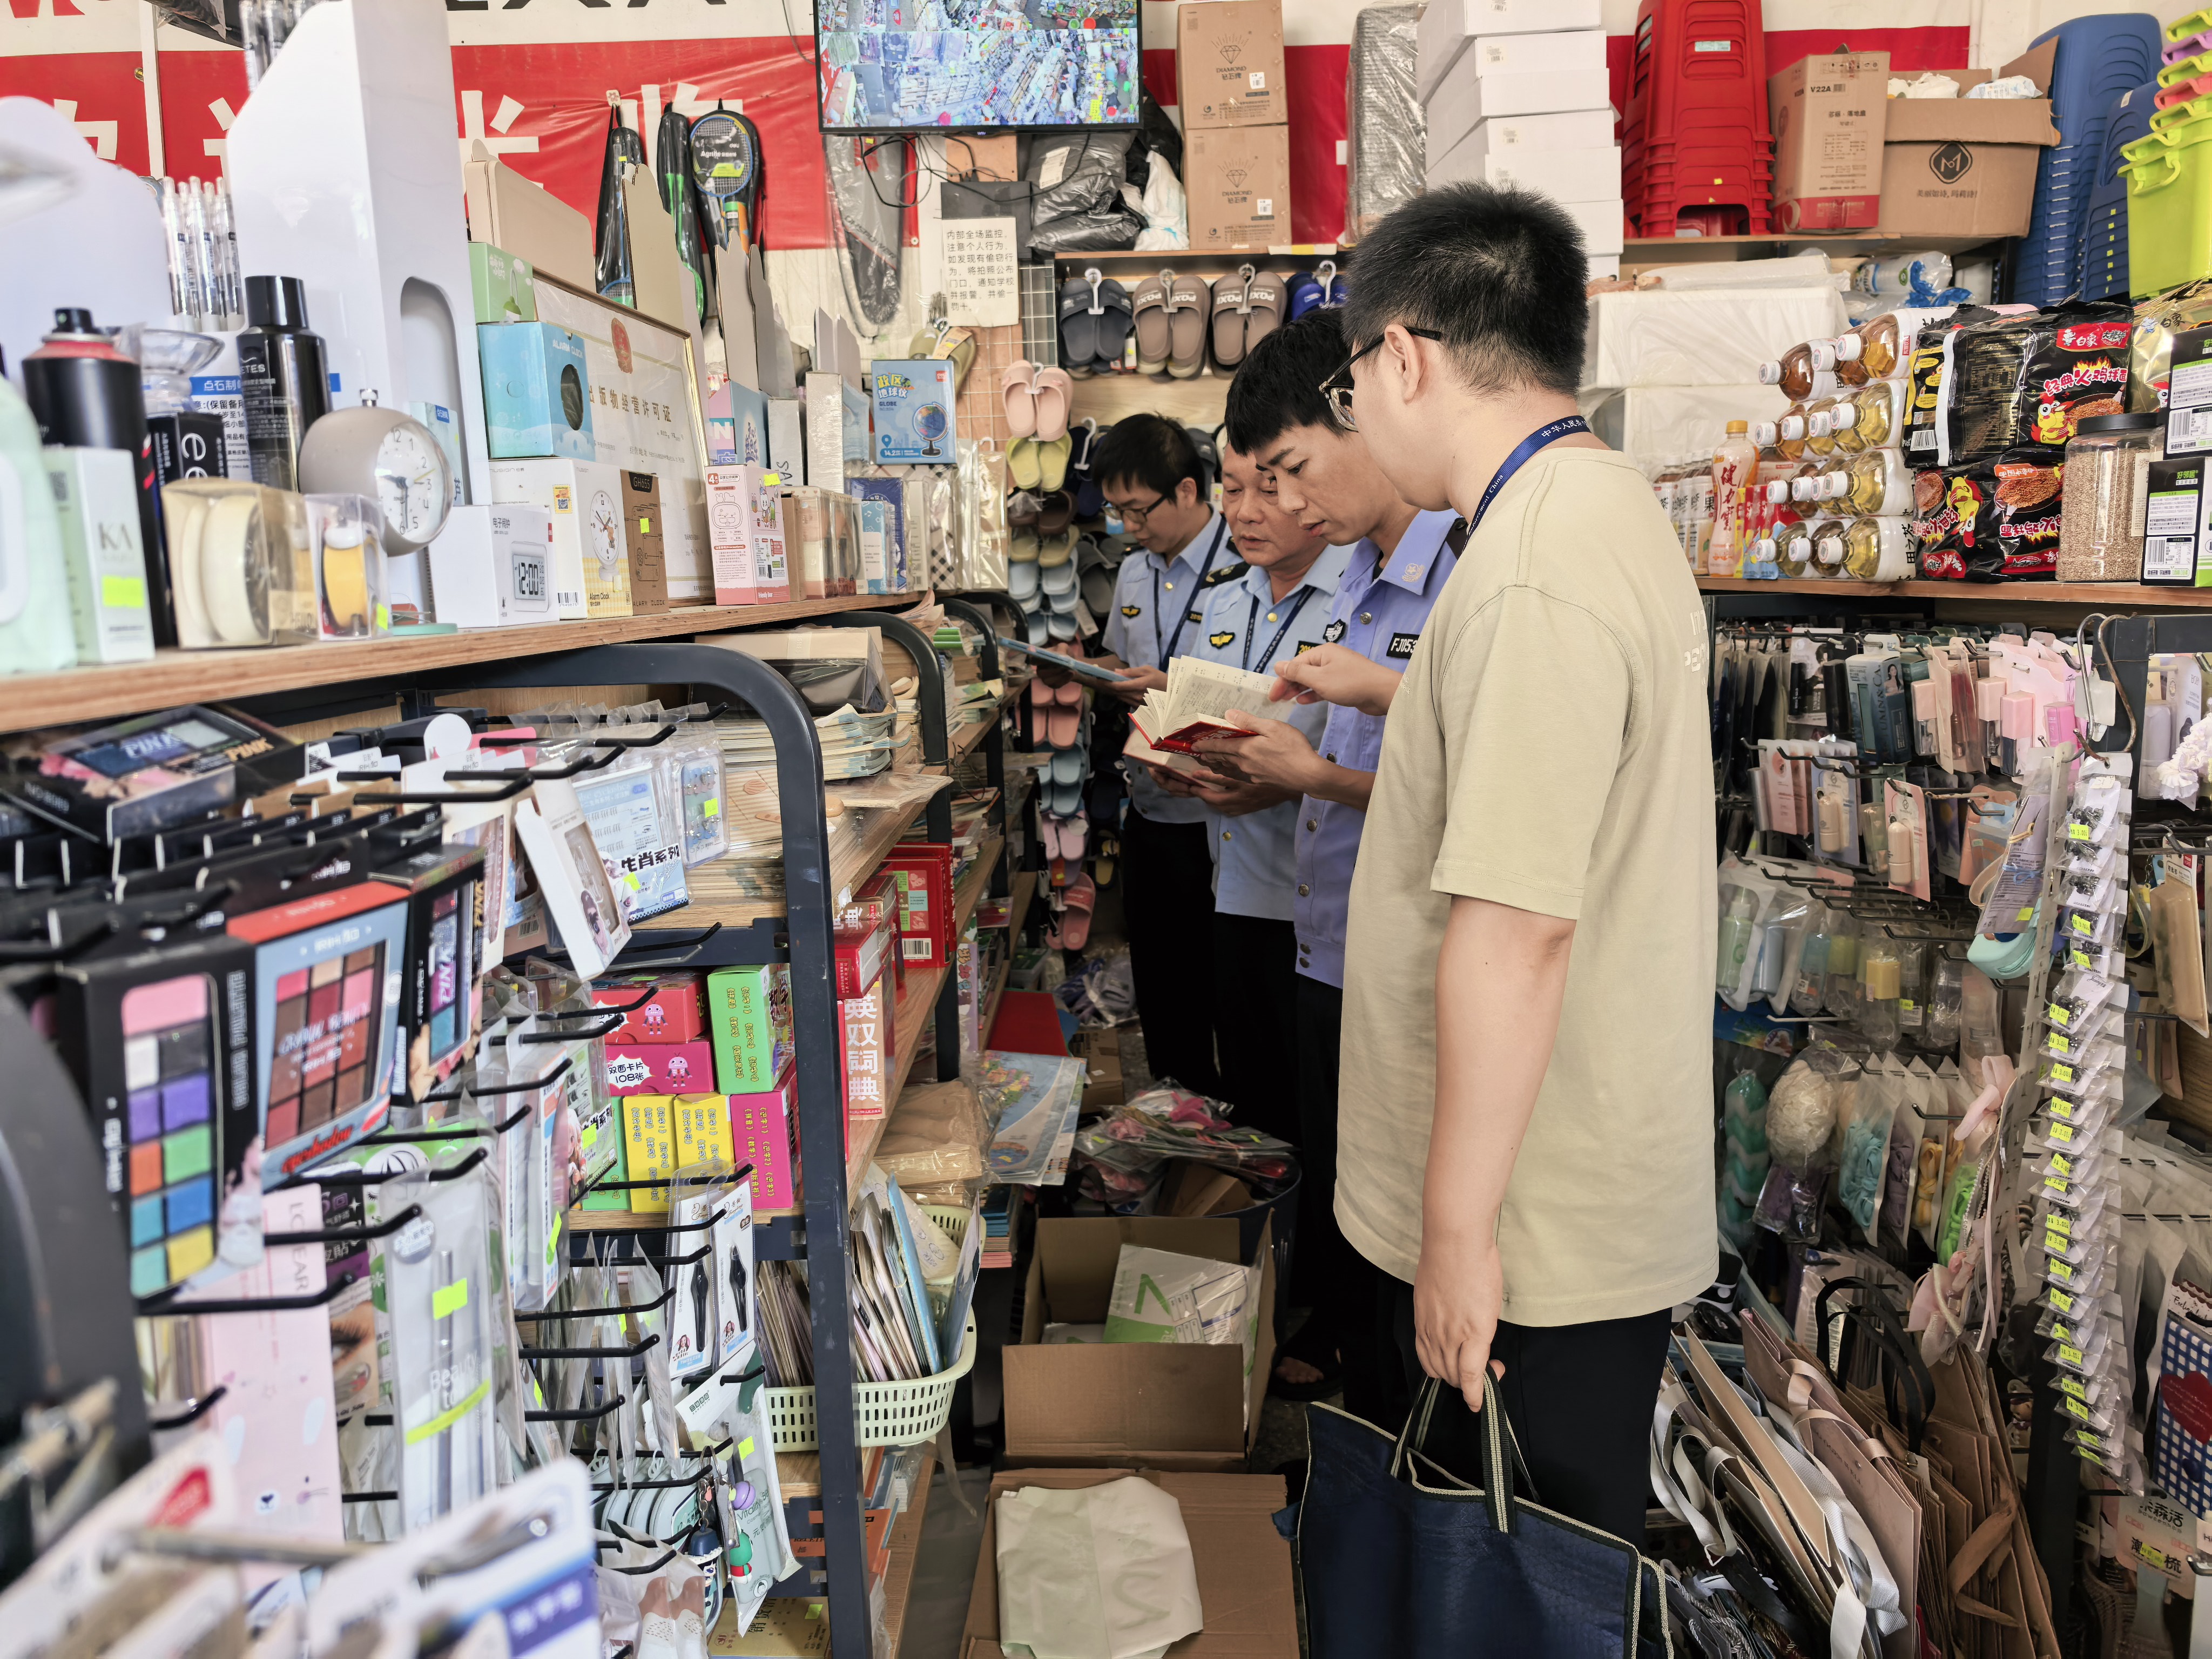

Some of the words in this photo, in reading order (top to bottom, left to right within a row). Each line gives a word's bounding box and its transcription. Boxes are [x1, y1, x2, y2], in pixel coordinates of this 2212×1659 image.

[2160, 312, 2186, 328] 白象
[553, 339, 570, 352] ALARM
[2076, 335, 2098, 347] 白象
[2044, 366, 2128, 396] 经典火鸡拌面
[1489, 475, 1503, 493] China
[622, 844, 680, 873] 生肖系列
[609, 1063, 644, 1074] 双面卡片
[615, 1073, 645, 1084] 108张
